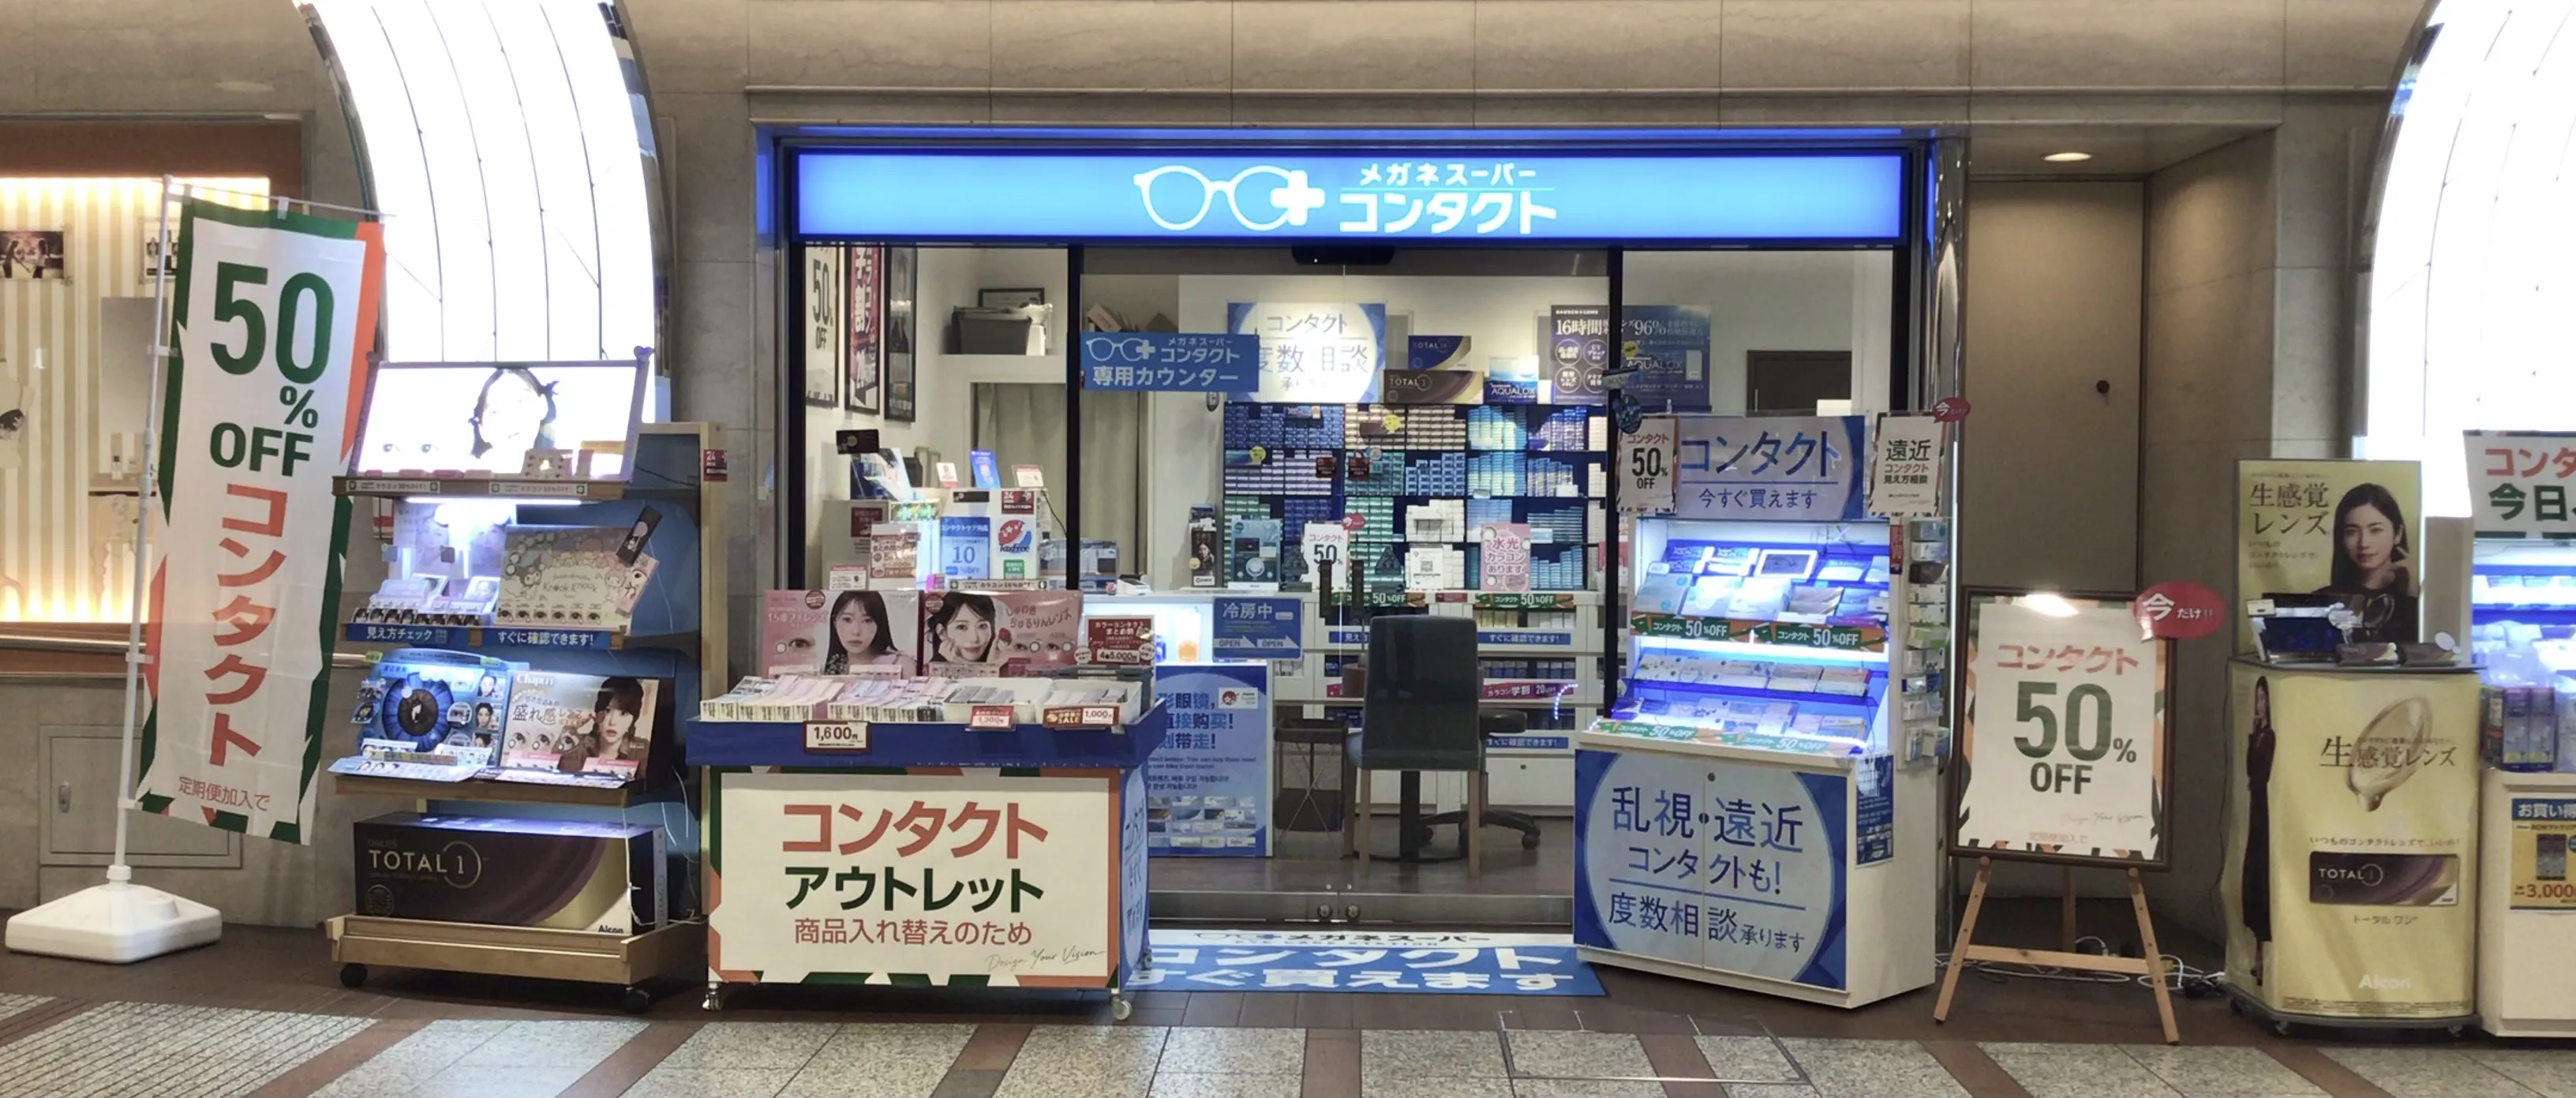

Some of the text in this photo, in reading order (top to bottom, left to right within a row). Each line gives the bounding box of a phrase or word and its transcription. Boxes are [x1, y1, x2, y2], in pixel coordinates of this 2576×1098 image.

[1360, 163, 1536, 186] メガネスーパー
[1340, 190, 1556, 234] コンタクト
[211, 262, 335, 384] 50
[1267, 313, 1348, 334] コンタクト
[1168, 338, 1233, 347] メガネスーパー
[1161, 347, 1240, 364] コンタクト
[1092, 366, 1238, 387] 専用カウンター
[1627, 434, 1669, 444] コンタクト
[210, 422, 314, 478] OFF
[1681, 431, 1840, 478] コンタクト
[1885, 439, 1931, 461] 遠近
[1884, 463, 1928, 474] コンタクト
[1637, 478, 1655, 489] OFF
[1884, 475, 1928, 484] 見え方相談
[1699, 488, 1817, 509] 今すぐ買えます
[2249, 482, 2329, 508] 生感覚
[2488, 482, 2576, 522] 今日
[2253, 511, 2329, 535] レンズ
[1309, 534, 1343, 542] コンタクト
[1492, 538, 1520, 550] 水光
[953, 546, 975, 564] 10
[1486, 553, 1526, 563] カラコン
[1488, 565, 1523, 575] あります
[1222, 602, 1272, 620] 冷房中
[204, 483, 288, 766] コンタクト
[365, 627, 432, 641] 見え方チェック
[1653, 621, 1683, 632] コンタクト
[497, 631, 594, 646] すぐに確認できます!
[1488, 633, 1559, 643] すぐに確認できます!
[1777, 631, 1810, 642] コンタクト
[1998, 644, 2139, 675] コンタクト
[2320, 736, 2457, 769] 生感覚レンズ
[2030, 762, 2094, 795] OFF
[178, 775, 271, 811] 定期便加入で
[782, 800, 1049, 860] コンタクト
[1611, 785, 1804, 854] 乱視・遠近
[369, 849, 447, 875] TOTAL
[1628, 845, 1781, 894] コンタクトも!
[2319, 868, 2364, 880] TOTAL
[784, 865, 1044, 913] アウトレット
[598, 924, 624, 934] Alcon
[2353, 915, 2391, 924] トータル
[795, 917, 1032, 946] 商品入れ替えのため
[986, 945, 1106, 972] Design Your Vision
[1151, 947, 1562, 969] コンタクト
[2358, 974, 2411, 990] Alcon
